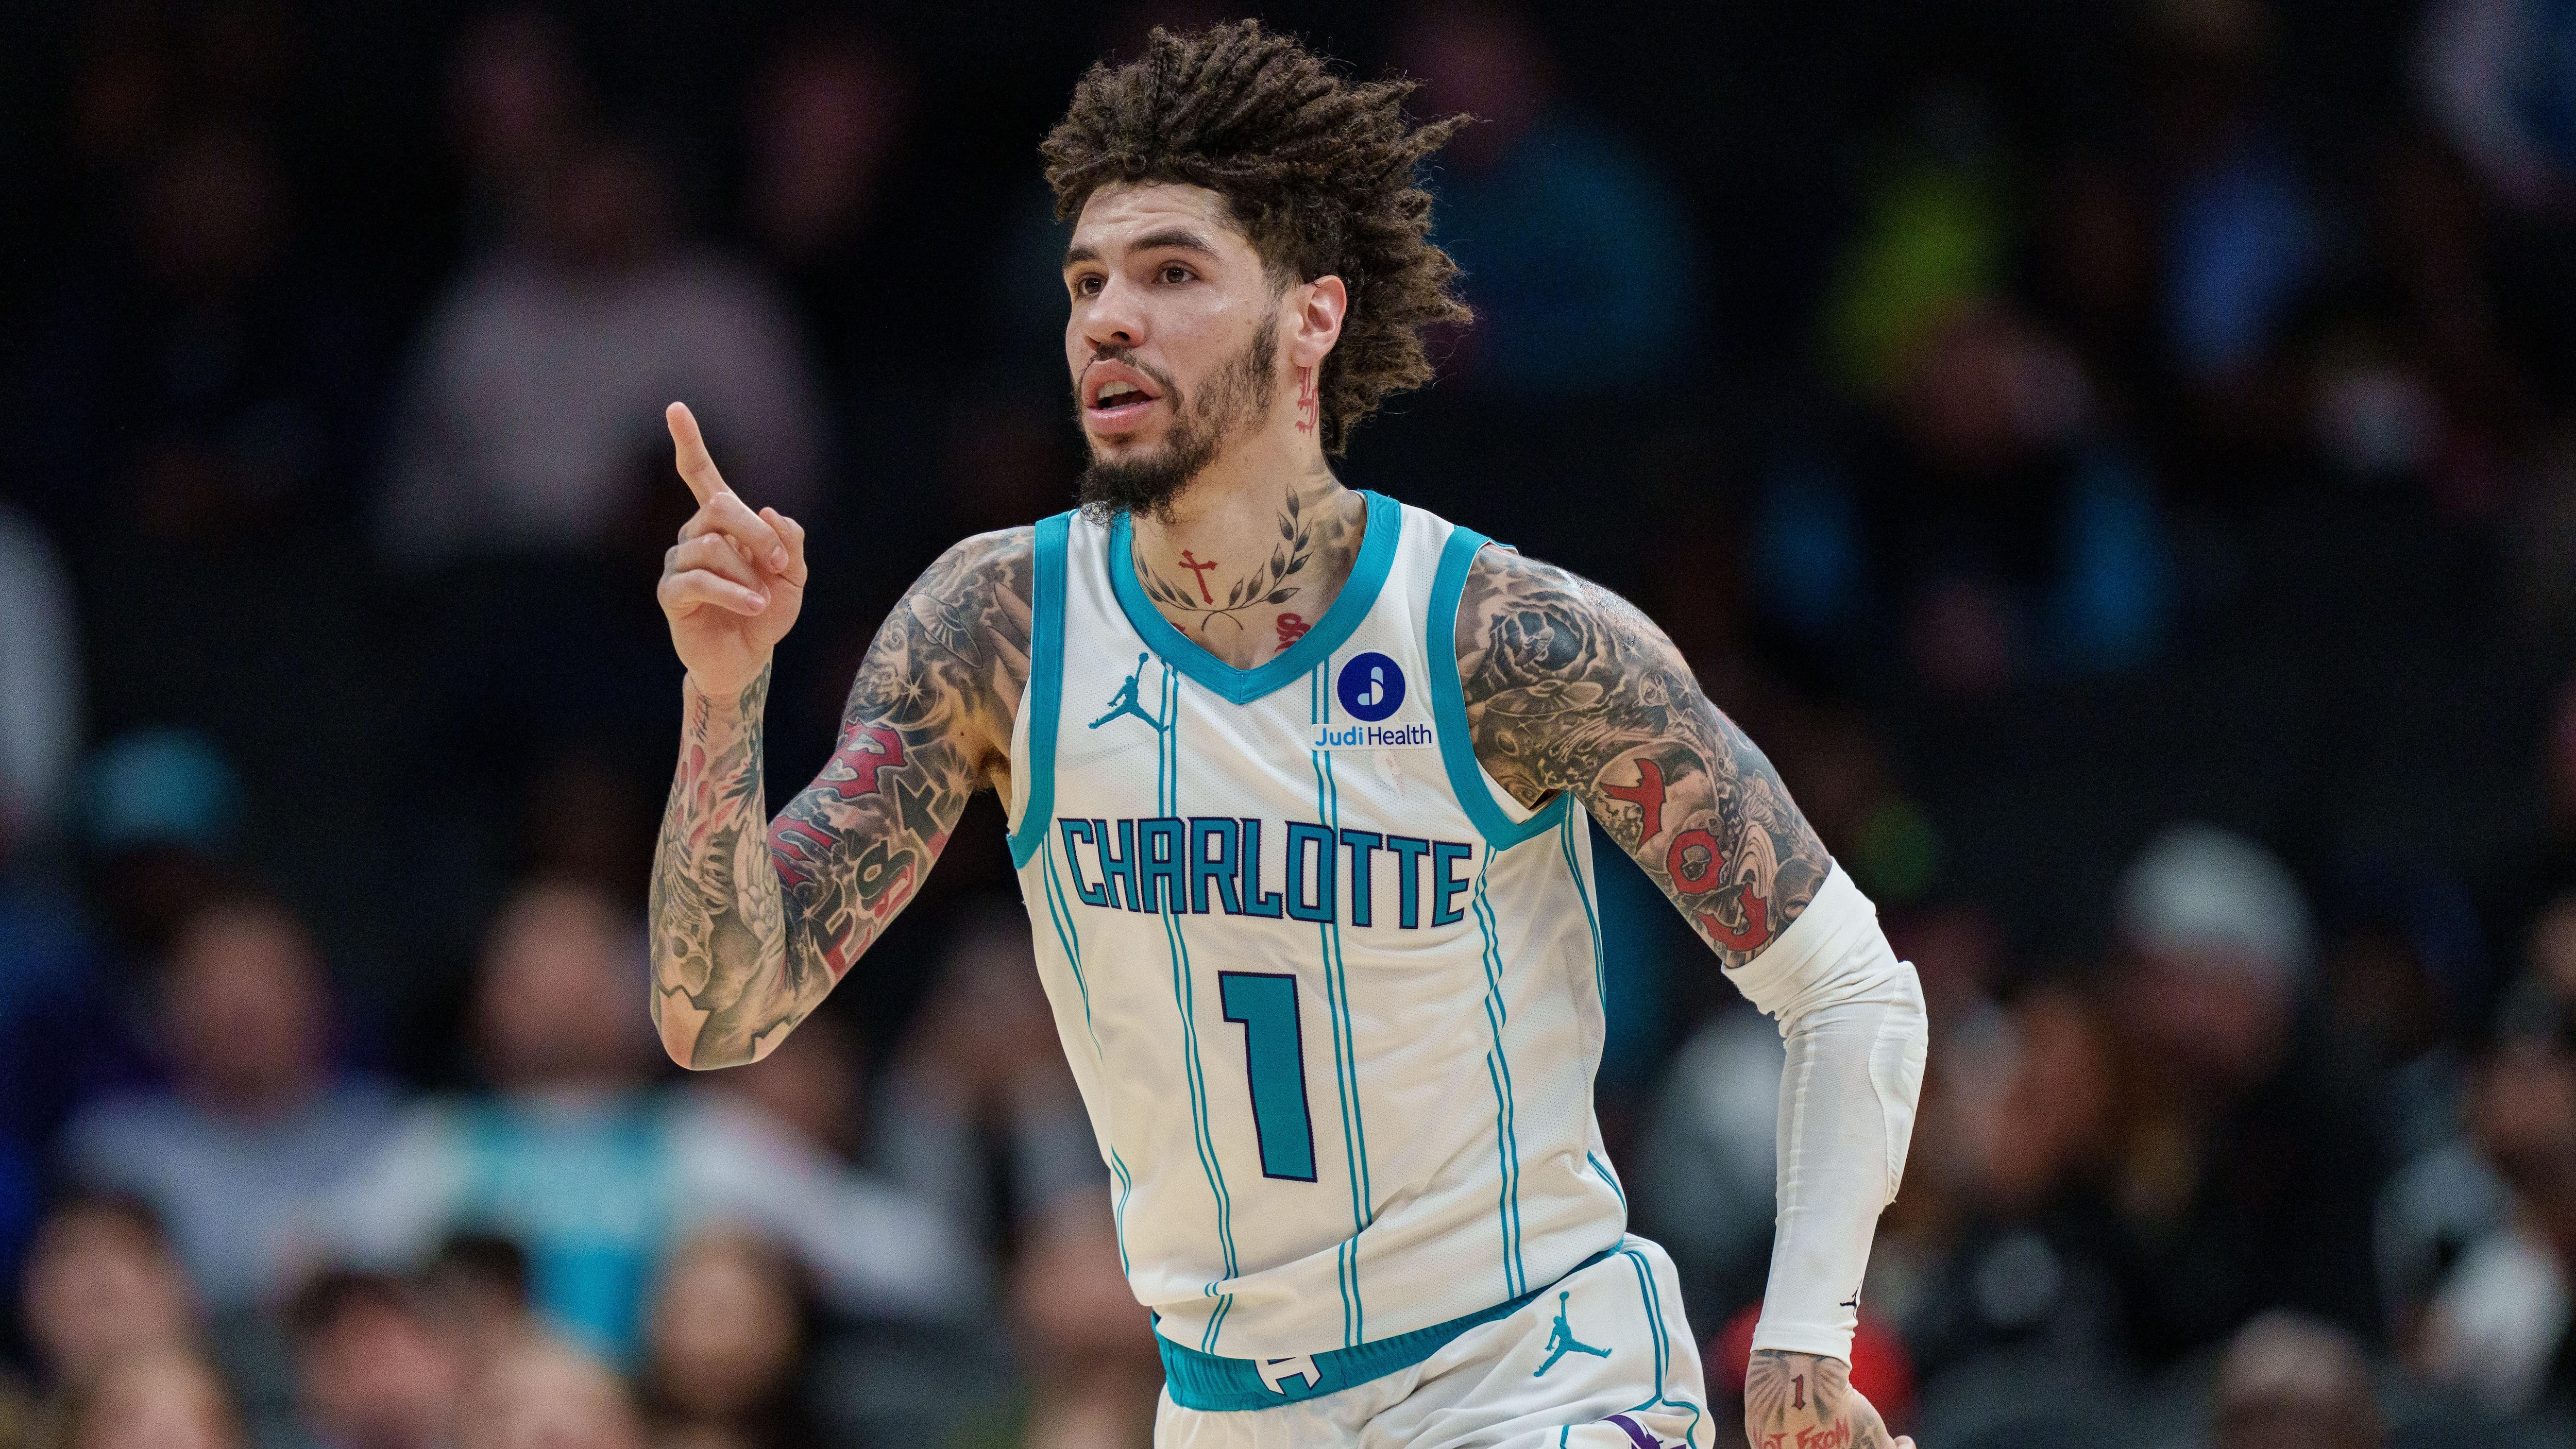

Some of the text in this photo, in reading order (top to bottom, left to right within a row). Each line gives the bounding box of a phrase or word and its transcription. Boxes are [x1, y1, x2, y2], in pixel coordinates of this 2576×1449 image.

[1315, 724, 1432, 746] Judi Health
[1057, 817, 1472, 929] CHARLOTTE
[1218, 970, 1317, 1183] 1
[1791, 1374, 1806, 1410] 1
